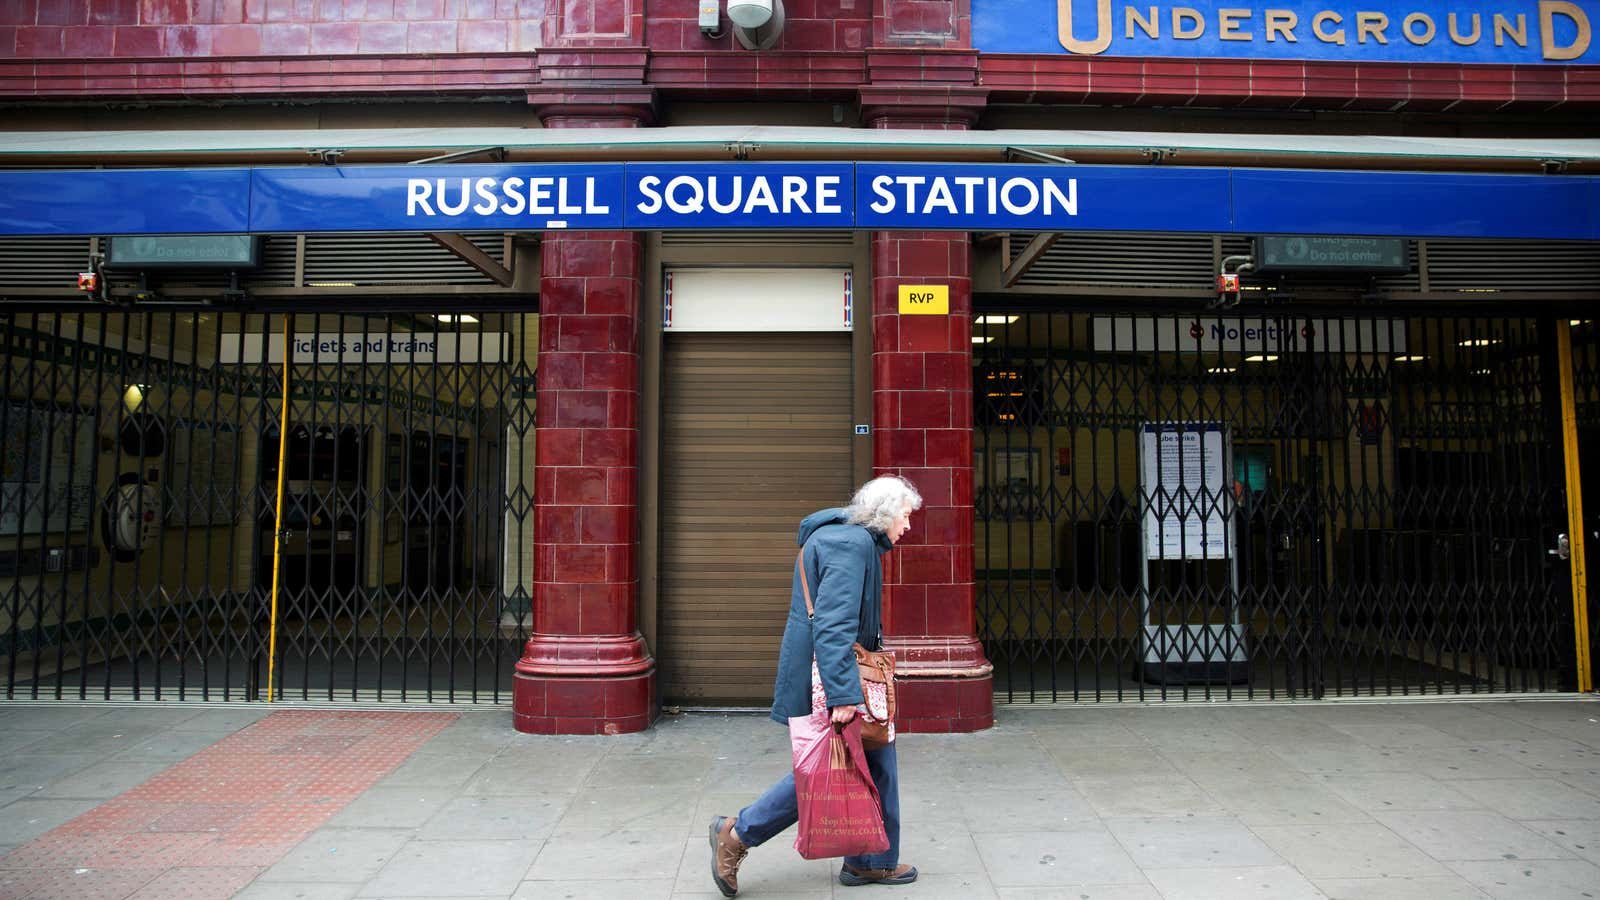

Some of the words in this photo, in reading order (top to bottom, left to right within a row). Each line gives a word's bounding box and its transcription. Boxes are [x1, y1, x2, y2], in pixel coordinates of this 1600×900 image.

[1057, 0, 1592, 60] UNDERGROUND
[406, 176, 609, 217] RUSSELL
[636, 175, 842, 214] SQUARE
[870, 175, 1079, 216] STATION
[1310, 250, 1328, 261] Do
[1330, 250, 1350, 261] not
[909, 293, 934, 304] RVP
[1211, 324, 1239, 340] No
[352, 339, 383, 353] and
[389, 339, 437, 353] trains
